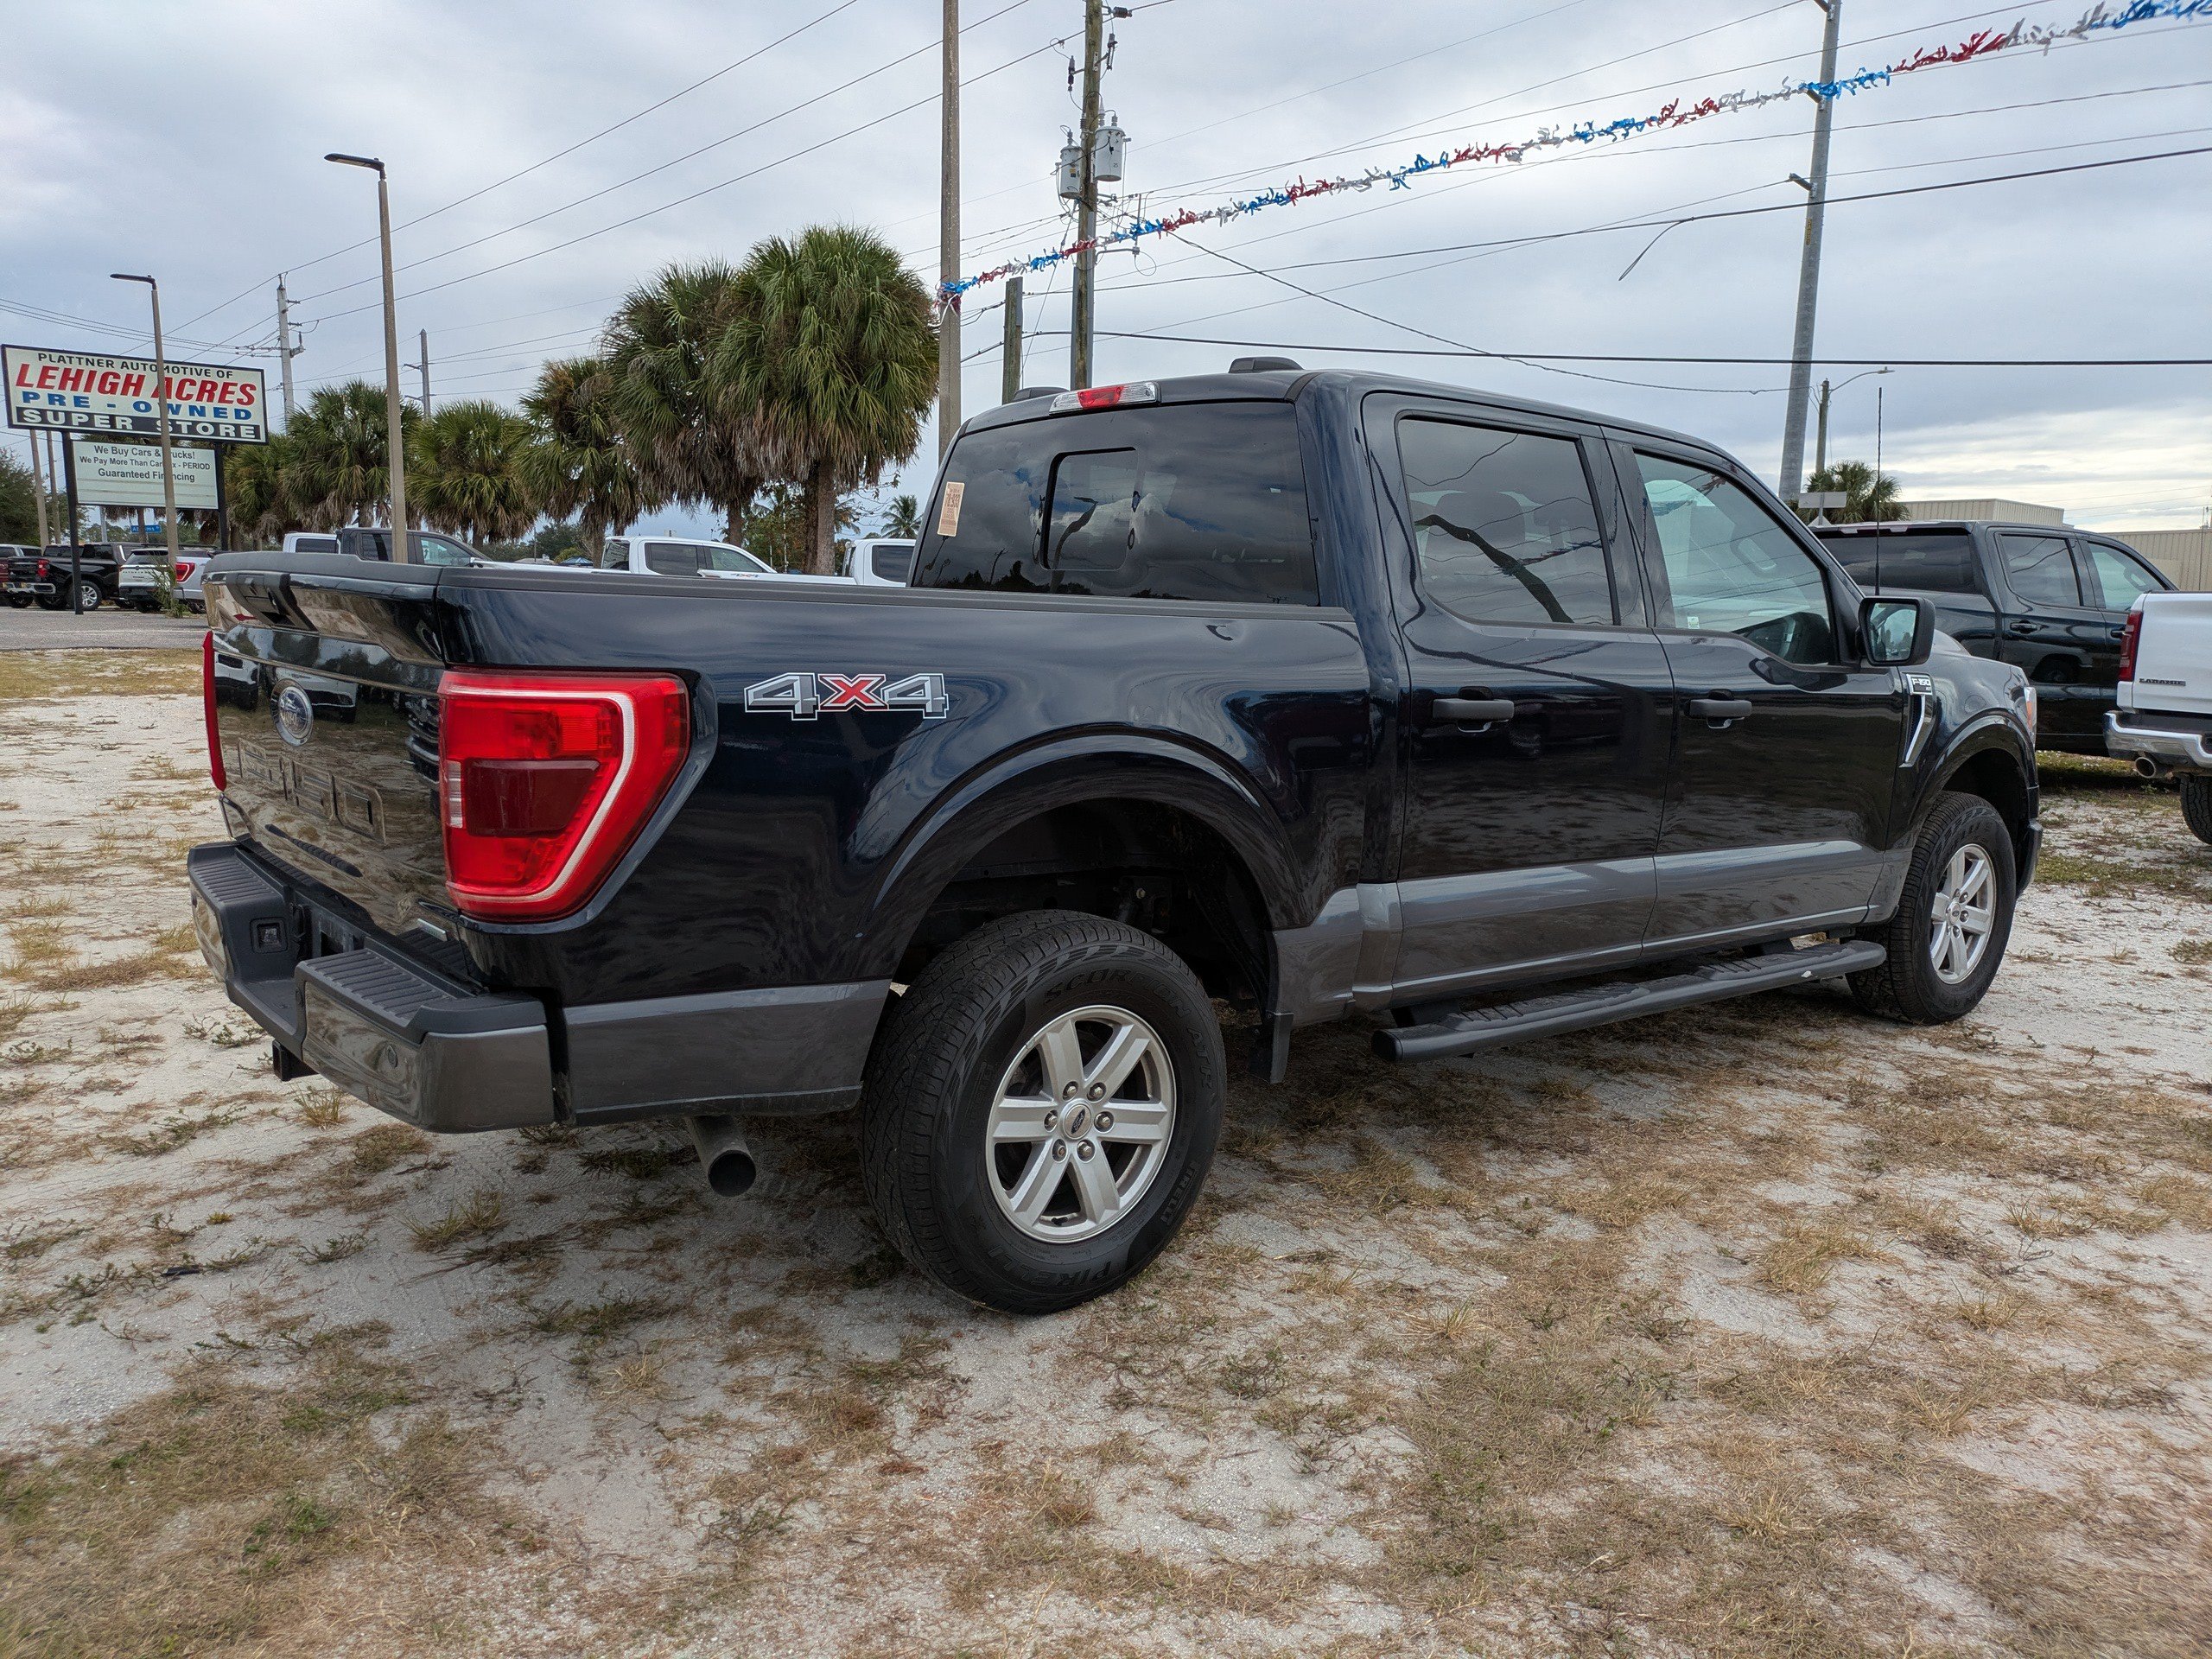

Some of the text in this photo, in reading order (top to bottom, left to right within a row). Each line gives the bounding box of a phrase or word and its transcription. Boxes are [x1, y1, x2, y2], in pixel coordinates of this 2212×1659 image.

[38, 353, 115, 369] PLATTNER
[216, 370, 233, 379] OF
[16, 364, 257, 406] LEHIGH ACRES
[22, 409, 256, 439] SUPER STORE
[79, 455, 92, 464] We
[93, 456, 107, 466] Pay
[109, 457, 128, 466] More
[130, 458, 148, 467] Than
[182, 461, 211, 470] PERIOD
[93, 445, 195, 460] We Buy Cars & ucks!
[98, 467, 195, 483] Guaranteed Finncing
[1044, 968, 1213, 1090] SCORPION ATR
[987, 1244, 1112, 1286] PIRELLI
